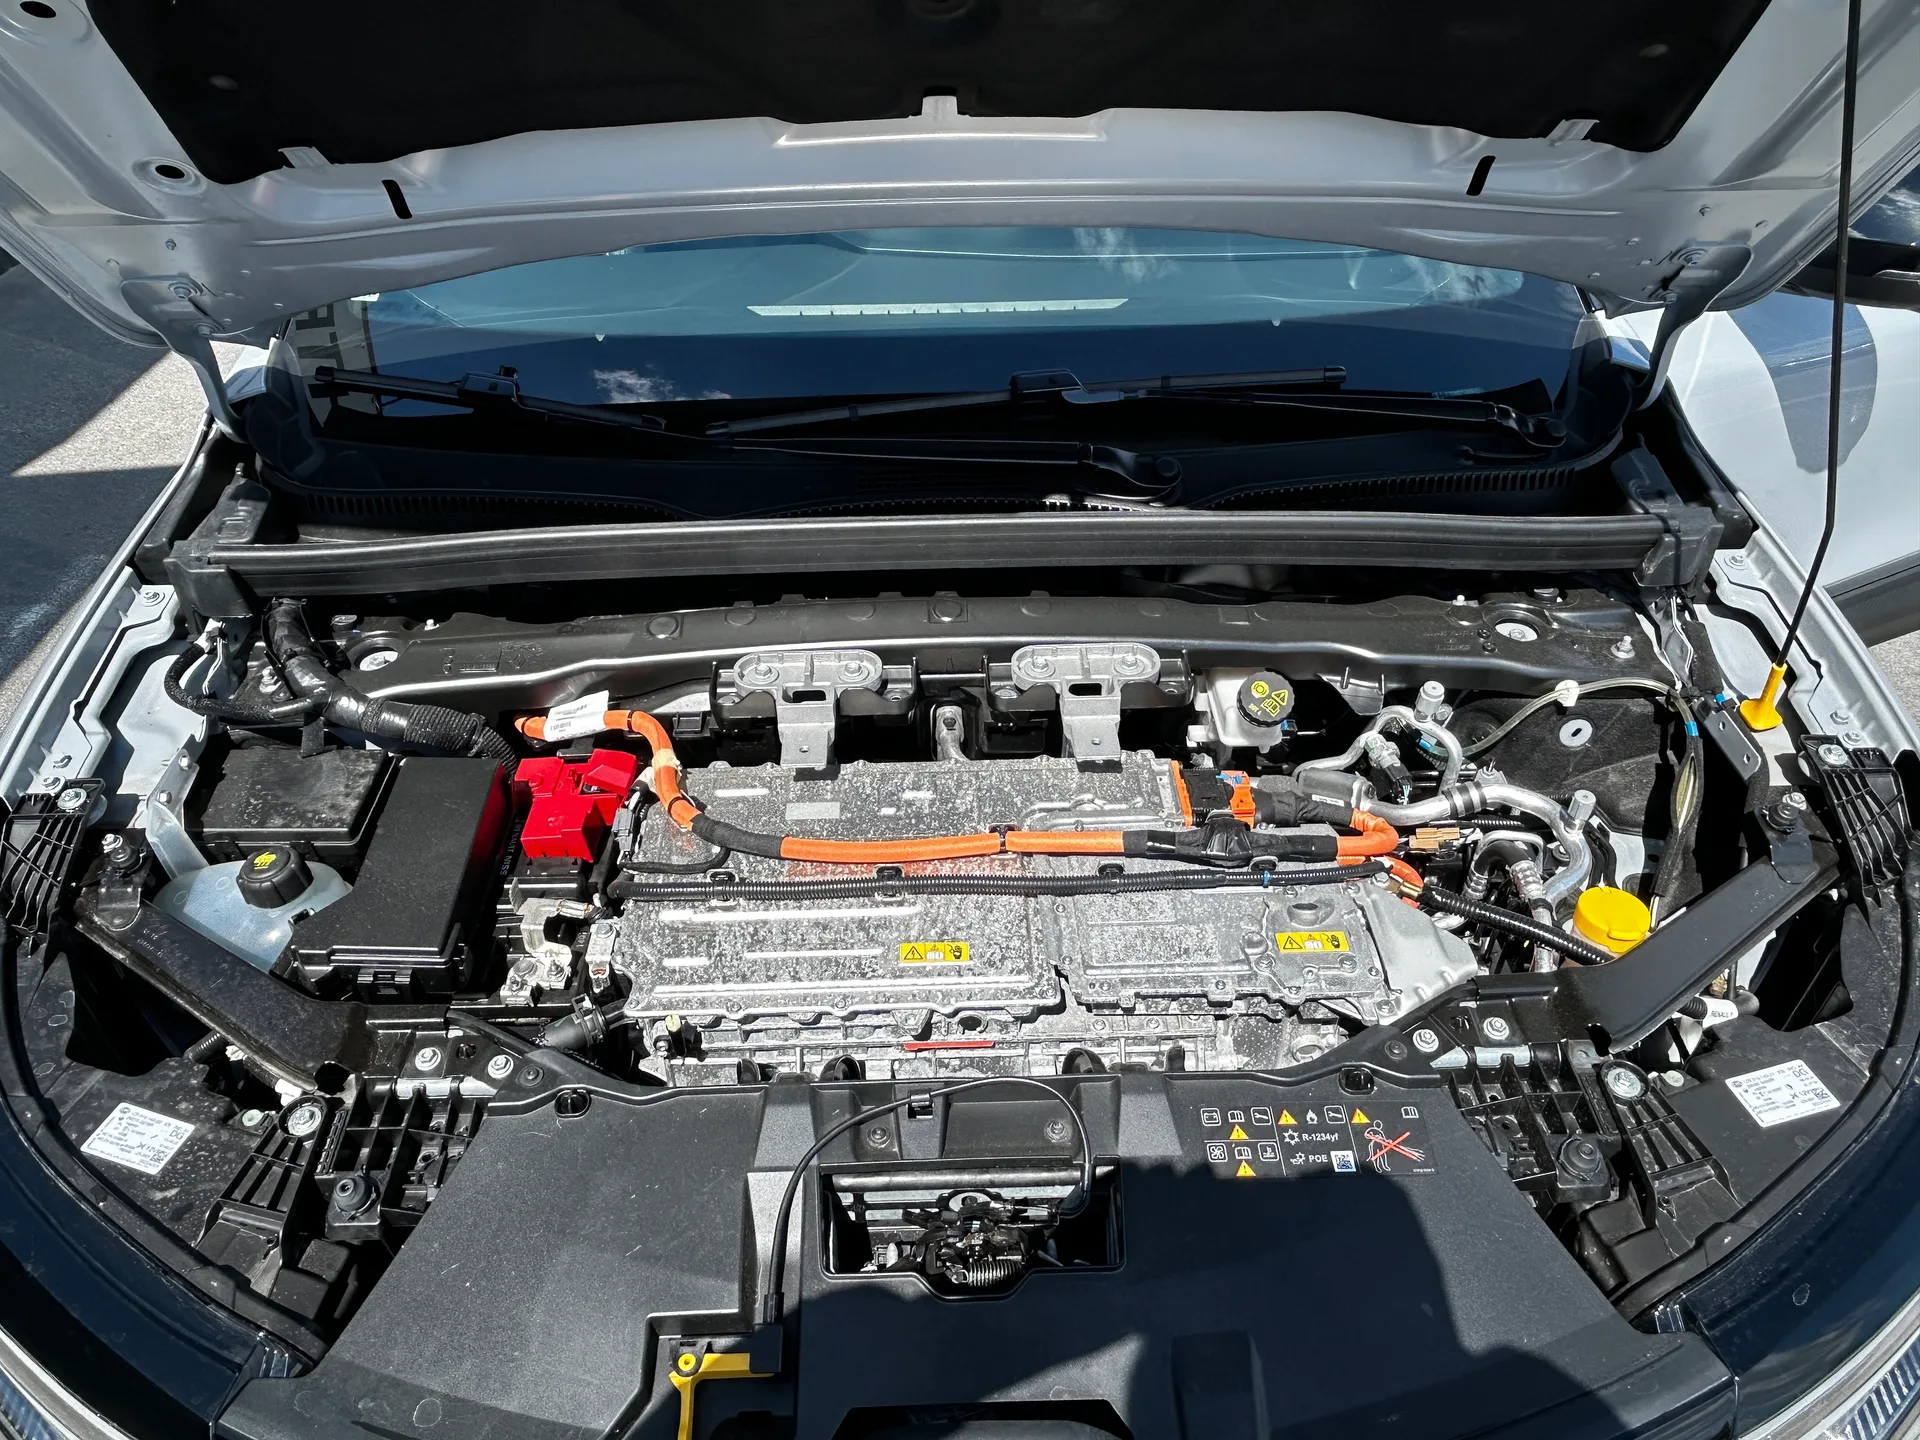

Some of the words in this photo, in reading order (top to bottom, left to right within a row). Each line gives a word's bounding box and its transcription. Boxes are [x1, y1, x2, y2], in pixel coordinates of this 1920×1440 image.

[1792, 1068, 1809, 1078] DG
[168, 1130, 185, 1140] DG
[1302, 1132, 1339, 1143] R-1234yf
[1308, 1154, 1328, 1163] POE
